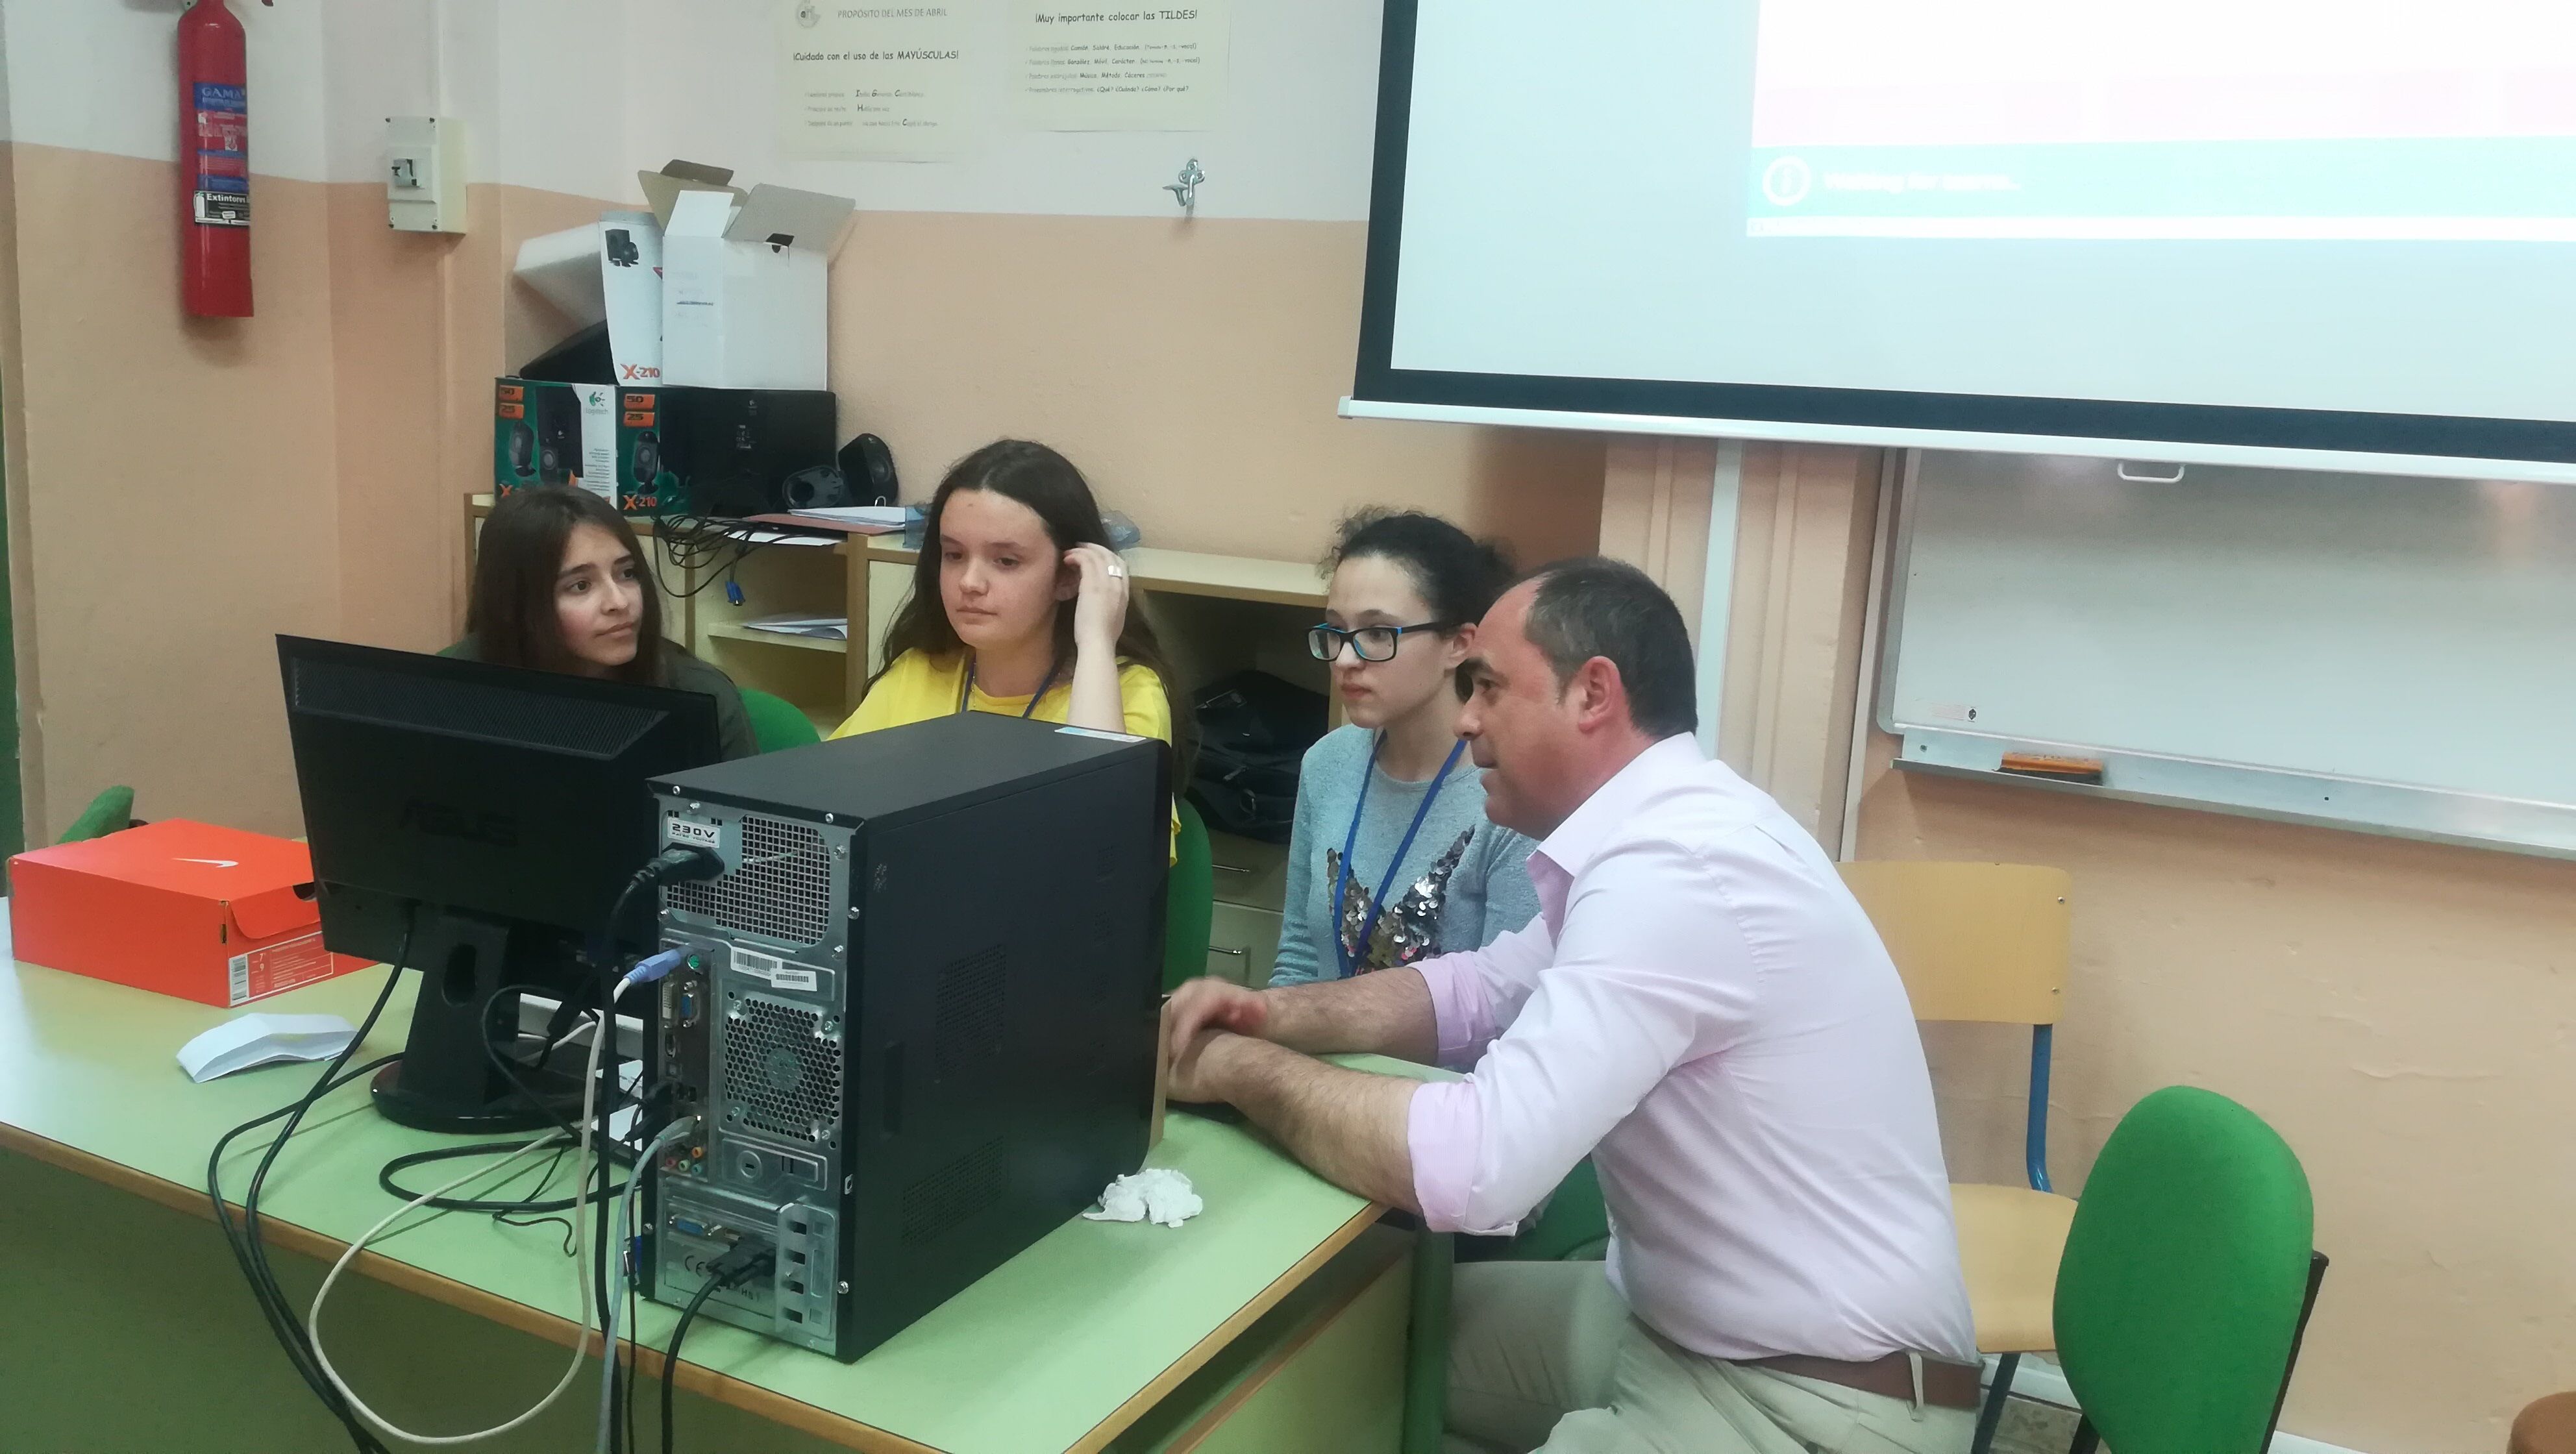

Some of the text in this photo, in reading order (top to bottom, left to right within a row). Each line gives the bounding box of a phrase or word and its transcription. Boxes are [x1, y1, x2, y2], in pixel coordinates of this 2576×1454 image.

[897, 8, 913, 18] MES
[915, 8, 924, 17] DE
[926, 8, 947, 16] ABRIL
[1058, 13, 1104, 25] importante
[1108, 12, 1139, 21] colocar
[1143, 11, 1155, 20] las
[1159, 10, 1197, 19] TILDES!
[843, 51, 850, 60] el
[870, 50, 880, 60] de
[883, 51, 893, 60] las
[897, 47, 959, 60] MAYÚSCULAS!
[621, 364, 660, 380] X-210
[672, 823, 715, 838] 230V
